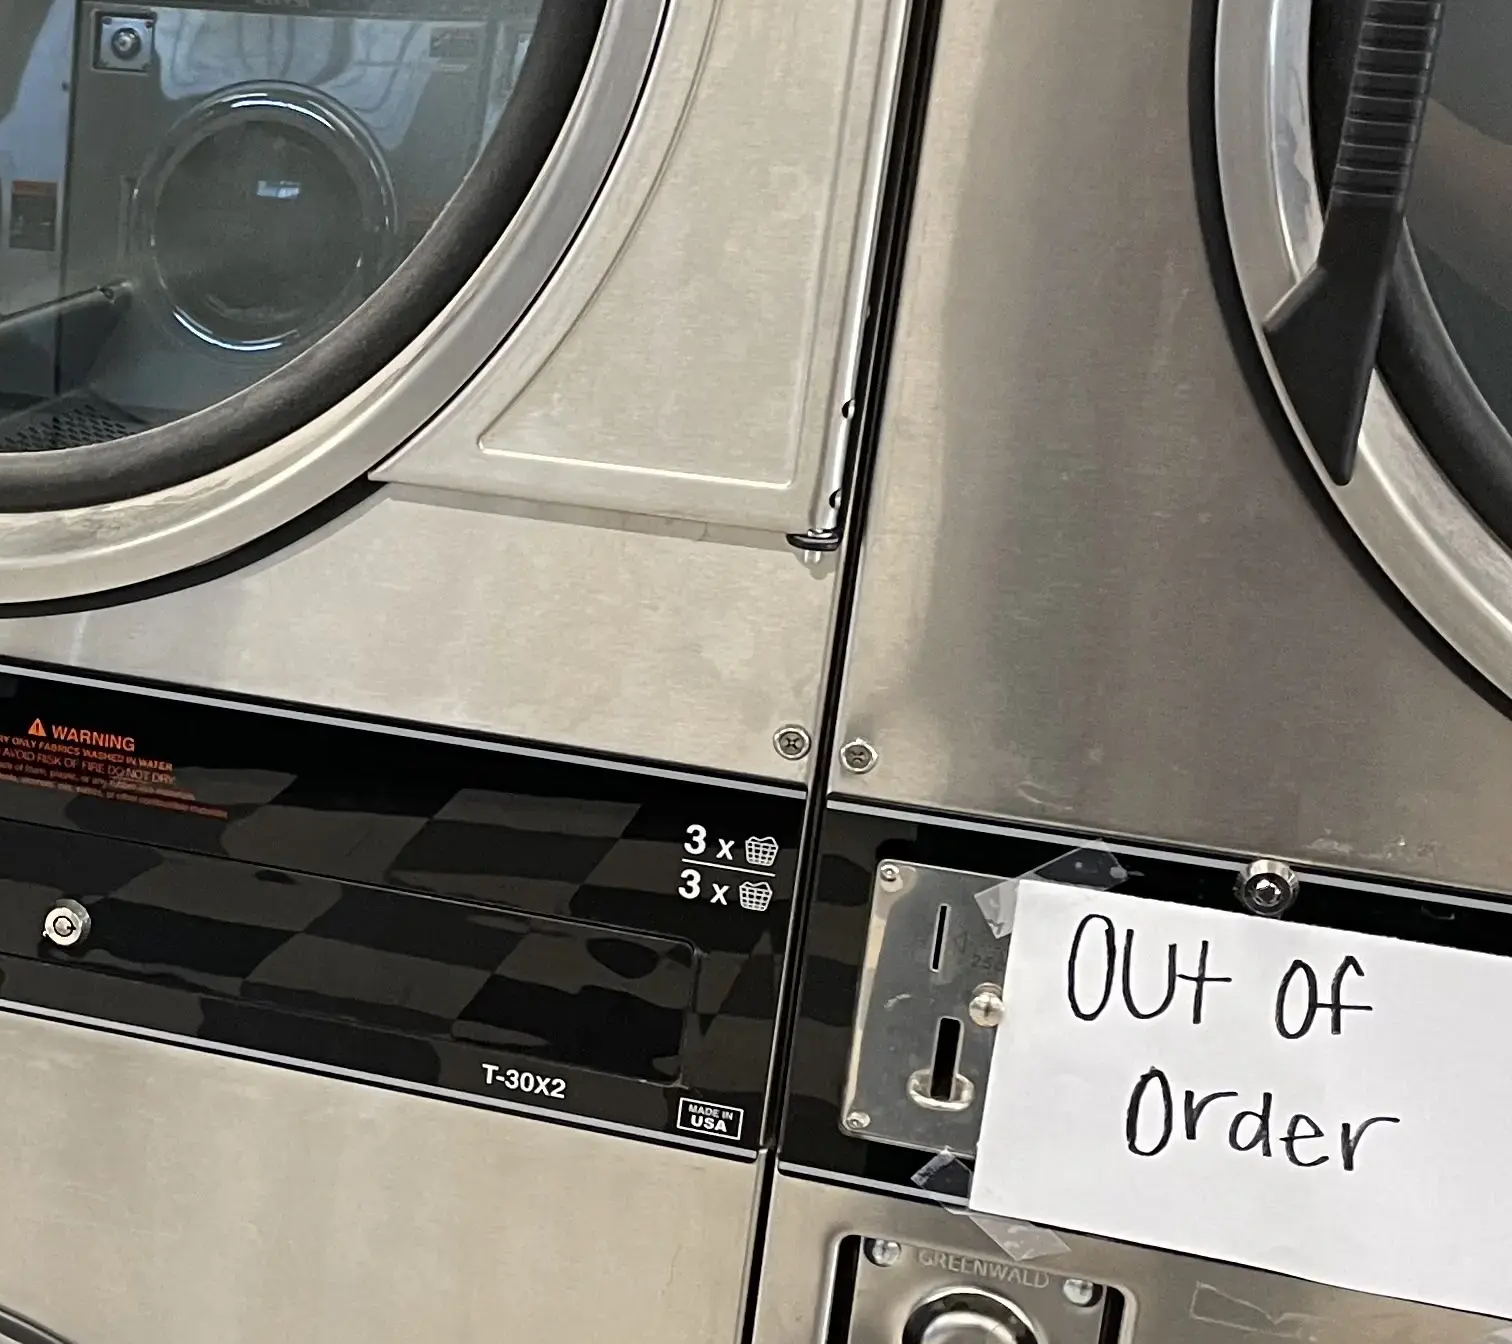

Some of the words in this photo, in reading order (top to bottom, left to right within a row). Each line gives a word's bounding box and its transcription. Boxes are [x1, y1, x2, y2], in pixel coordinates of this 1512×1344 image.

[11, 737, 37, 748] ONLY
[38, 740, 80, 757] FABRICS
[82, 747, 125, 763] WASHED
[126, 756, 138, 766] IN
[138, 758, 173, 772] WATER
[51, 724, 136, 752] WARNING
[2, 747, 35, 761] AVOID
[36, 752, 61, 766] RISK
[63, 757, 79, 768] OF
[81, 761, 105, 774] FIRE
[107, 765, 125, 777] DO
[126, 767, 150, 781] NOT
[684, 823, 707, 855] 3
[716, 837, 735, 860] x
[678, 869, 701, 900] 3
[710, 882, 728, 906] x
[482, 1063, 567, 1099] T-30X2
[688, 1104, 720, 1119] MADE
[721, 1110, 734, 1121] IN
[690, 1114, 728, 1134] USA
[1125, 1065, 1401, 1172] Order
[916, 1249, 1051, 1289] GREENWALD
